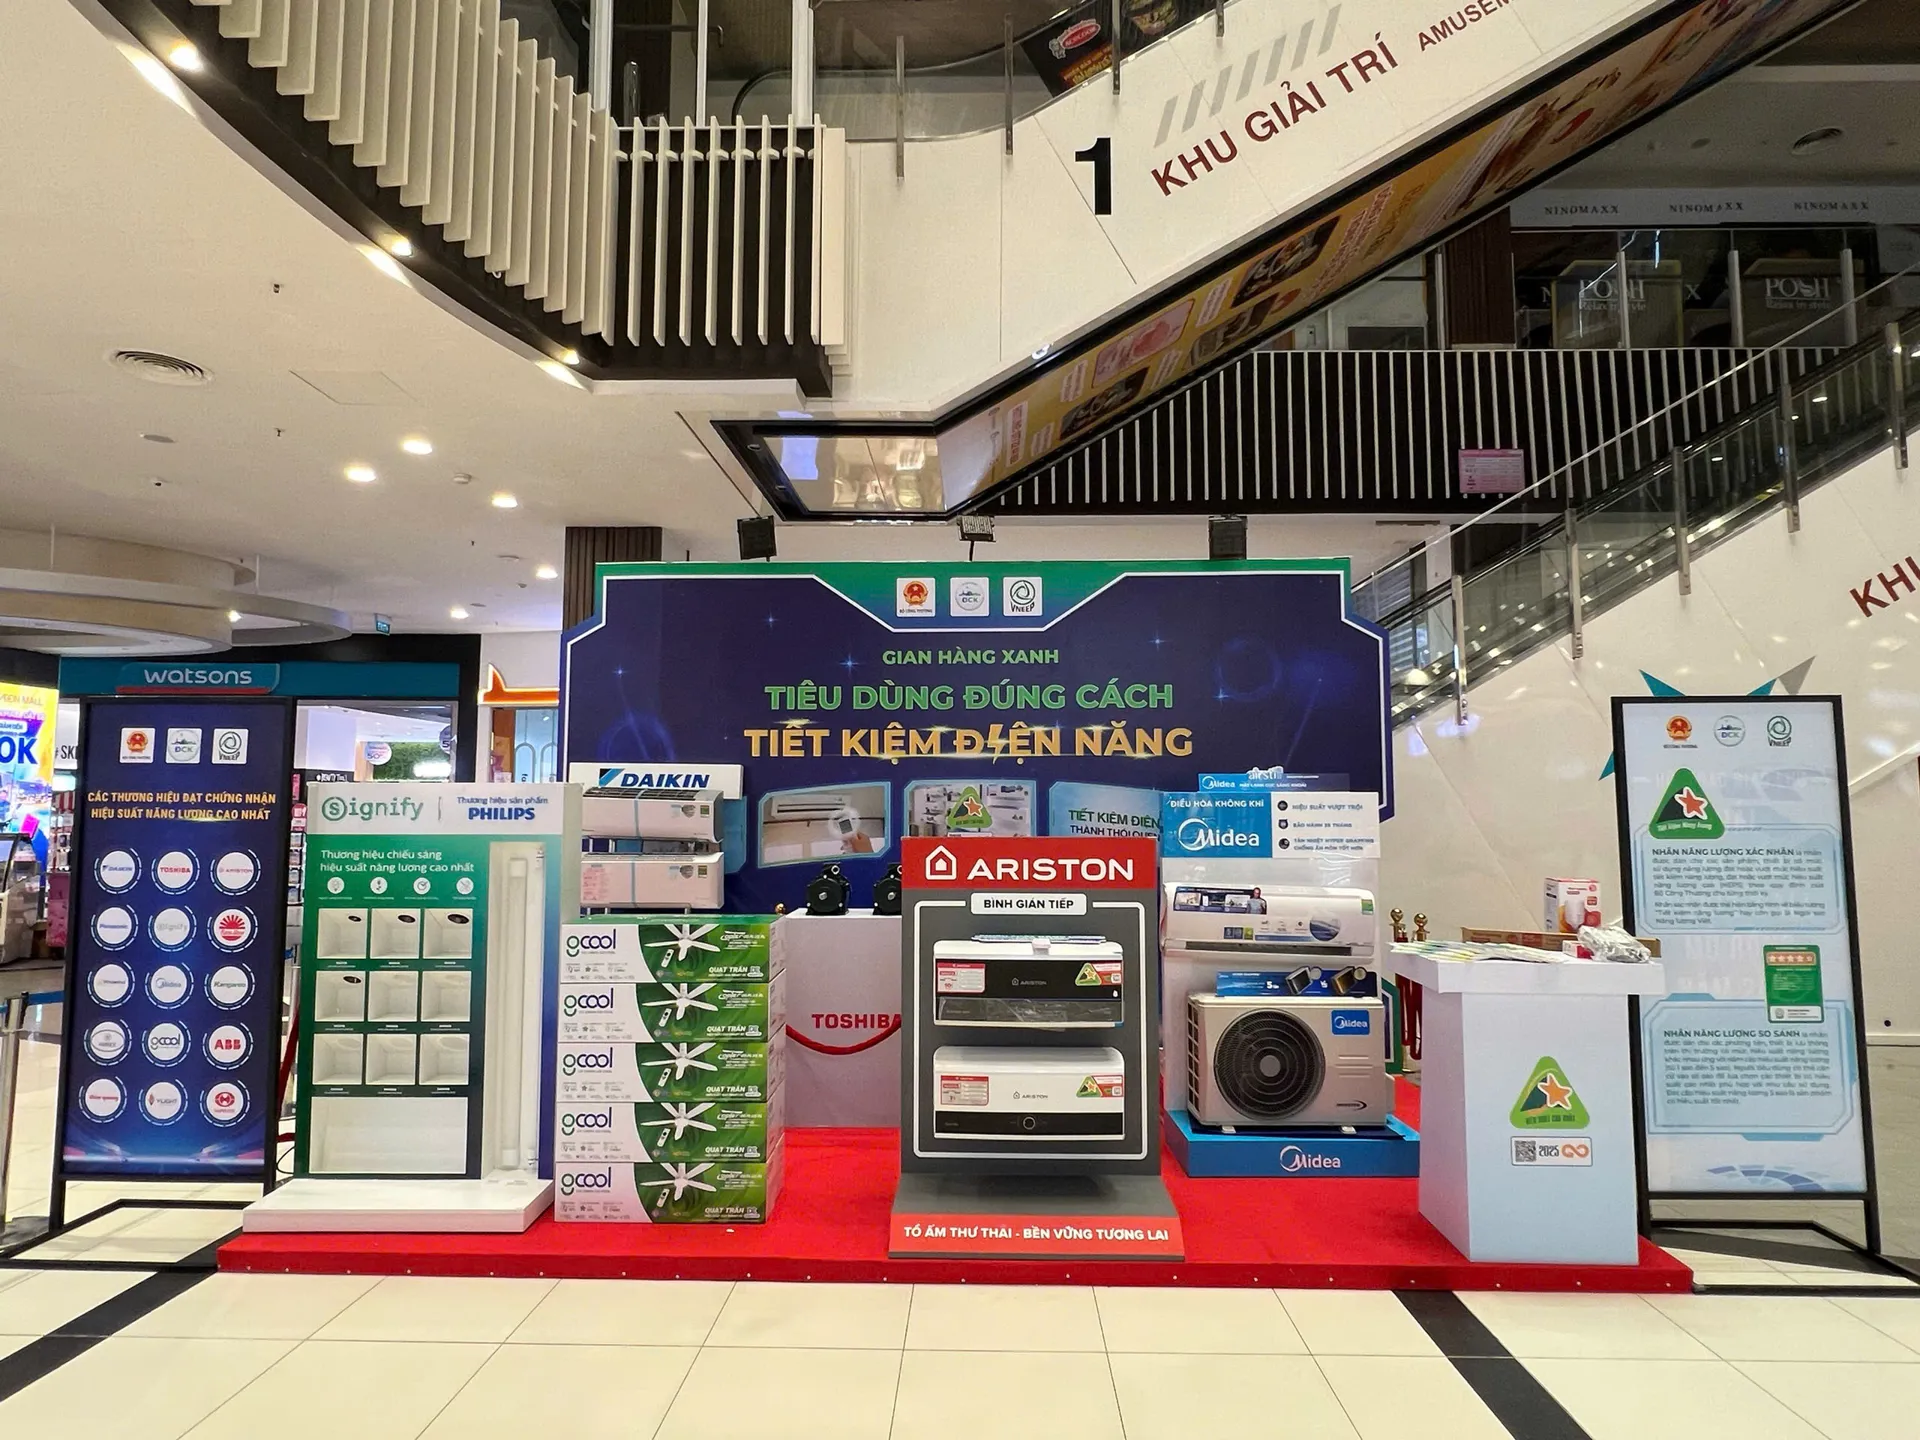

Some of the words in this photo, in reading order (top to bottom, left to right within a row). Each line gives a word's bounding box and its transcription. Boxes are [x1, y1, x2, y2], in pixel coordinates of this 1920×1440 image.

[1150, 130, 1239, 197] KHU
[1244, 80, 1327, 143] GIẢI
[1326, 31, 1400, 94] TRÍ
[1074, 137, 1112, 216] 1
[1544, 203, 1620, 217] NINOMAXX
[1765, 276, 1830, 299] POSH
[882, 650, 934, 665] GIAN
[938, 645, 996, 665] HÀNG
[1001, 649, 1059, 665] XANH
[144, 668, 252, 685] watsons
[764, 679, 843, 711] TIÊU
[853, 679, 954, 711] DÙNG
[963, 678, 1066, 710] ĐÚNG
[1075, 678, 1173, 709] CÁCH
[744, 721, 830, 757] TIẾT
[842, 722, 939, 765] KIỆM
[1075, 720, 1193, 757] NĂNG
[620, 773, 710, 788] DAIKIN
[88, 790, 109, 802] CÁC
[112, 791, 153, 803] THƯƠNG
[156, 791, 180, 804] HIỆU
[183, 792, 203, 803] ĐẠT
[205, 790, 242, 804] CHỨNG
[245, 791, 276, 805] NHẬN
[1215, 798, 1247, 808] KHÔNG
[1249, 798, 1264, 808] KHÍ
[91, 808, 114, 822] HIỆU
[117, 807, 143, 819] SUẤT
[145, 808, 175, 819] NĂNG
[215, 809, 239, 820] CAO
[241, 808, 271, 820] NHẤT
[468, 807, 535, 820] PHILIPS
[1068, 807, 1095, 822] TIẾT
[1097, 810, 1128, 826] KIỆM
[1186, 824, 1260, 850] Midea
[321, 849, 360, 860] Thương
[362, 849, 384, 861] hiệu
[387, 848, 414, 859] chiếu
[418, 850, 442, 861] sáng
[1681, 848, 1709, 856] NĂNG
[1745, 847, 1765, 856] XÁC
[320, 862, 344, 873] hiệu
[346, 861, 367, 872] suất
[369, 863, 395, 875] năng
[429, 864, 449, 873] cao
[450, 862, 475, 873] nhất
[967, 857, 1134, 881] ARISTON
[983, 896, 1013, 910] BÌNH
[1015, 895, 1046, 910] GIÁN
[1049, 895, 1074, 910] TIẾP
[566, 928, 616, 957] gcool
[563, 987, 614, 1017] gcool
[811, 1013, 901, 1029] TOSHIBA
[1336, 1018, 1368, 1029] Midea
[1758, 1029, 1771, 1038] SO
[214, 1038, 241, 1051] ABB
[562, 1047, 613, 1076] gcool
[561, 1106, 612, 1136] gcool
[1538, 1144, 1560, 1157] 2025
[1284, 1148, 1341, 1171] Midea
[560, 1166, 612, 1196] gcool
[950, 1225, 979, 1239] THƯ
[1023, 1223, 1050, 1240] BỀN
[1053, 1223, 1093, 1240] VỮNG
[1097, 1226, 1144, 1241] TƯƠNG
[1147, 1229, 1168, 1241] LAI
